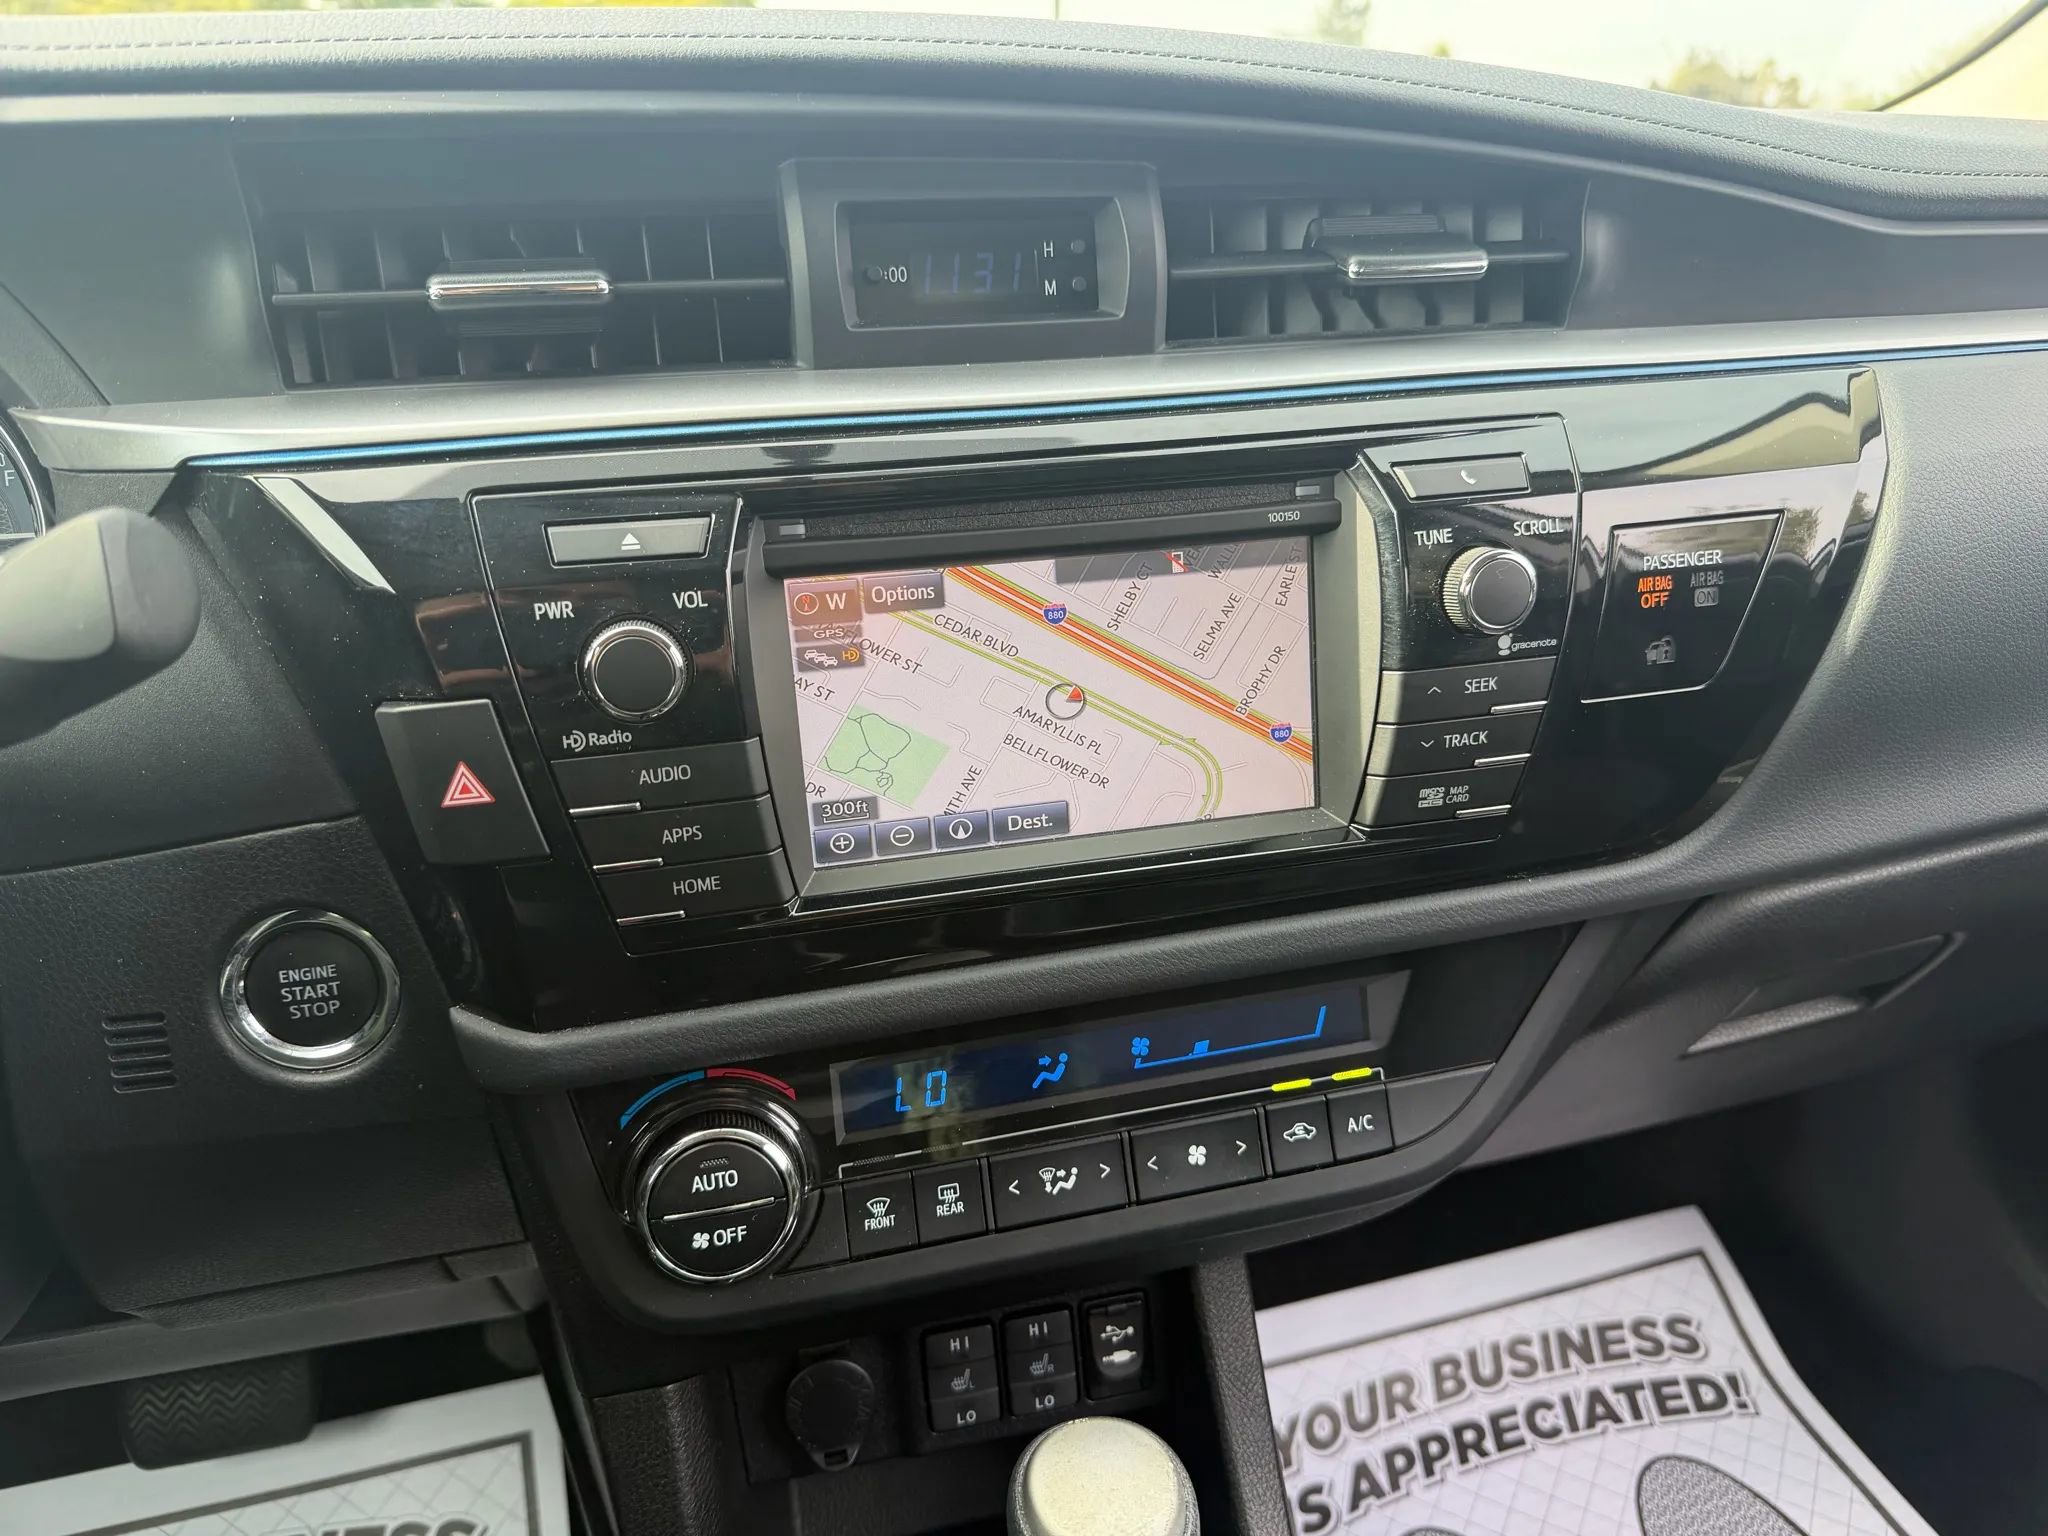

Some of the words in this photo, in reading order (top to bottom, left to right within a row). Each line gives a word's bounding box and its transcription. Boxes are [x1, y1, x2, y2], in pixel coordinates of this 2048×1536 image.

[1043, 240, 1054, 258] H
[1045, 280, 1057, 296] M
[1267, 511, 1301, 523] 100150
[1513, 518, 1564, 537] SCROLL
[1414, 528, 1454, 546] TUNE
[1643, 549, 1723, 571] PASSENGER
[1275, 564, 1298, 606] EARLE
[1637, 576, 1655, 592] AIR
[1655, 574, 1673, 591] BAG
[1690, 572, 1706, 588] AIR
[1706, 570, 1725, 586] BAG
[672, 590, 708, 610] VOL
[825, 593, 846, 611] W
[872, 583, 935, 606] Options
[1107, 580, 1142, 631] SHELBY
[1137, 561, 1153, 581] CT
[1640, 592, 1670, 609] OFF
[1696, 590, 1717, 605] ON
[534, 600, 575, 621] PWR
[1048, 610, 1065, 620] 880
[813, 628, 844, 639] GPS
[1193, 616, 1227, 660] SELMA
[1221, 592, 1242, 619] AVE
[934, 613, 982, 644] CEDAR
[982, 632, 1019, 658] BLVD
[1511, 637, 1557, 652] gracenote
[902, 658, 923, 675] ST
[1235, 663, 1273, 716] BROPHY
[1267, 646, 1287, 666] DR
[1464, 676, 1499, 694] SEEK
[814, 685, 836, 701] ST
[588, 729, 633, 746] Radio
[1012, 706, 1087, 748] AMARYLLIS
[1087, 738, 1104, 756] PL
[1274, 729, 1290, 739] 880
[1443, 730, 1489, 749] TRACK
[1003, 733, 1090, 780] BELLFLOWER
[1089, 768, 1110, 790] DR
[638, 764, 692, 785] AUDIO
[960, 765, 982, 795] AVE
[805, 781, 827, 799] DR
[1445, 793, 1470, 804] CARD
[1449, 785, 1470, 795] MAP
[821, 800, 869, 818] 300ft
[1007, 814, 1053, 832] Dest.
[661, 825, 703, 845] APPS
[672, 875, 721, 895] HOME
[278, 964, 338, 984] ENGINE
[280, 981, 341, 1003] START
[289, 999, 341, 1020] STOP
[1346, 1113, 1375, 1134] A/C
[691, 1169, 739, 1194] AUTO
[936, 1200, 965, 1218] REAR
[864, 1214, 897, 1232] FRONT
[713, 1225, 748, 1246] OFF
[1029, 1321, 1049, 1338] HI
[950, 1335, 970, 1352] HI
[1430, 1315, 1702, 1403] BUSINESS
[1035, 1394, 1055, 1410] LO
[956, 1409, 977, 1425] LO
[1346, 1373, 1751, 1514] APPRECIATED!
